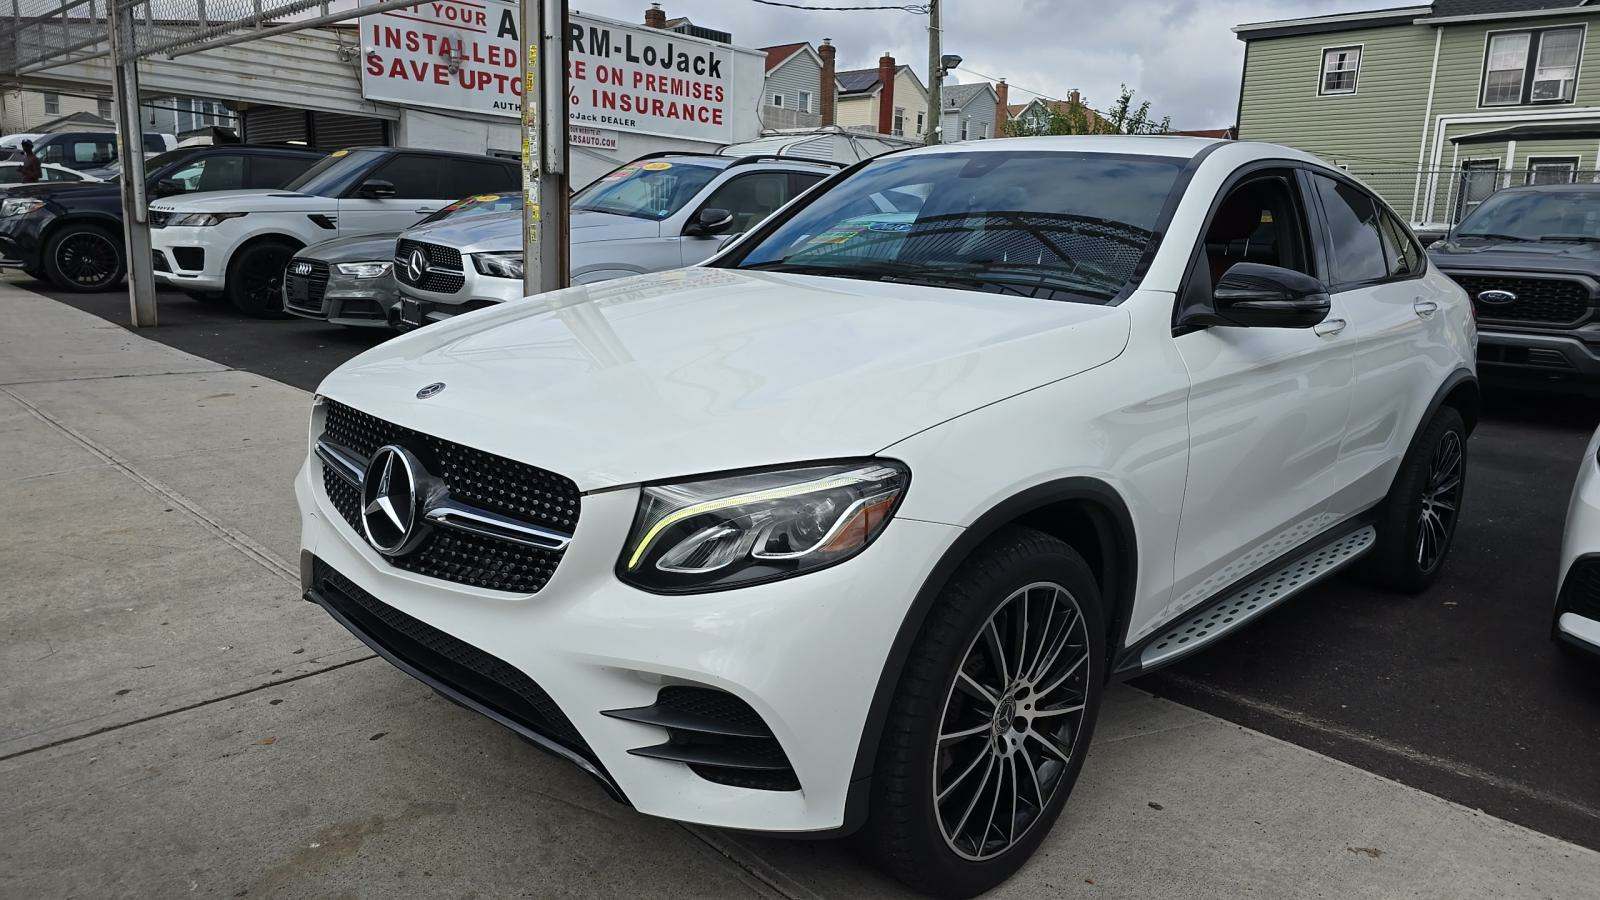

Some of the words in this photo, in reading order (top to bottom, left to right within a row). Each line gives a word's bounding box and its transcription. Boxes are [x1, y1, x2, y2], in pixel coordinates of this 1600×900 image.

[432, 3, 487, 26] YOUR
[373, 25, 517, 68] INSTALLED
[596, 65, 624, 86] ON
[633, 71, 724, 102] PREMISES
[367, 54, 450, 85] SAVE
[592, 89, 723, 125] INSURANCE
[493, 101, 522, 111] AUTH
[569, 112, 597, 121] oJack
[601, 115, 636, 127] DEALER
[569, 134, 616, 147] ARSAUTO.COM
